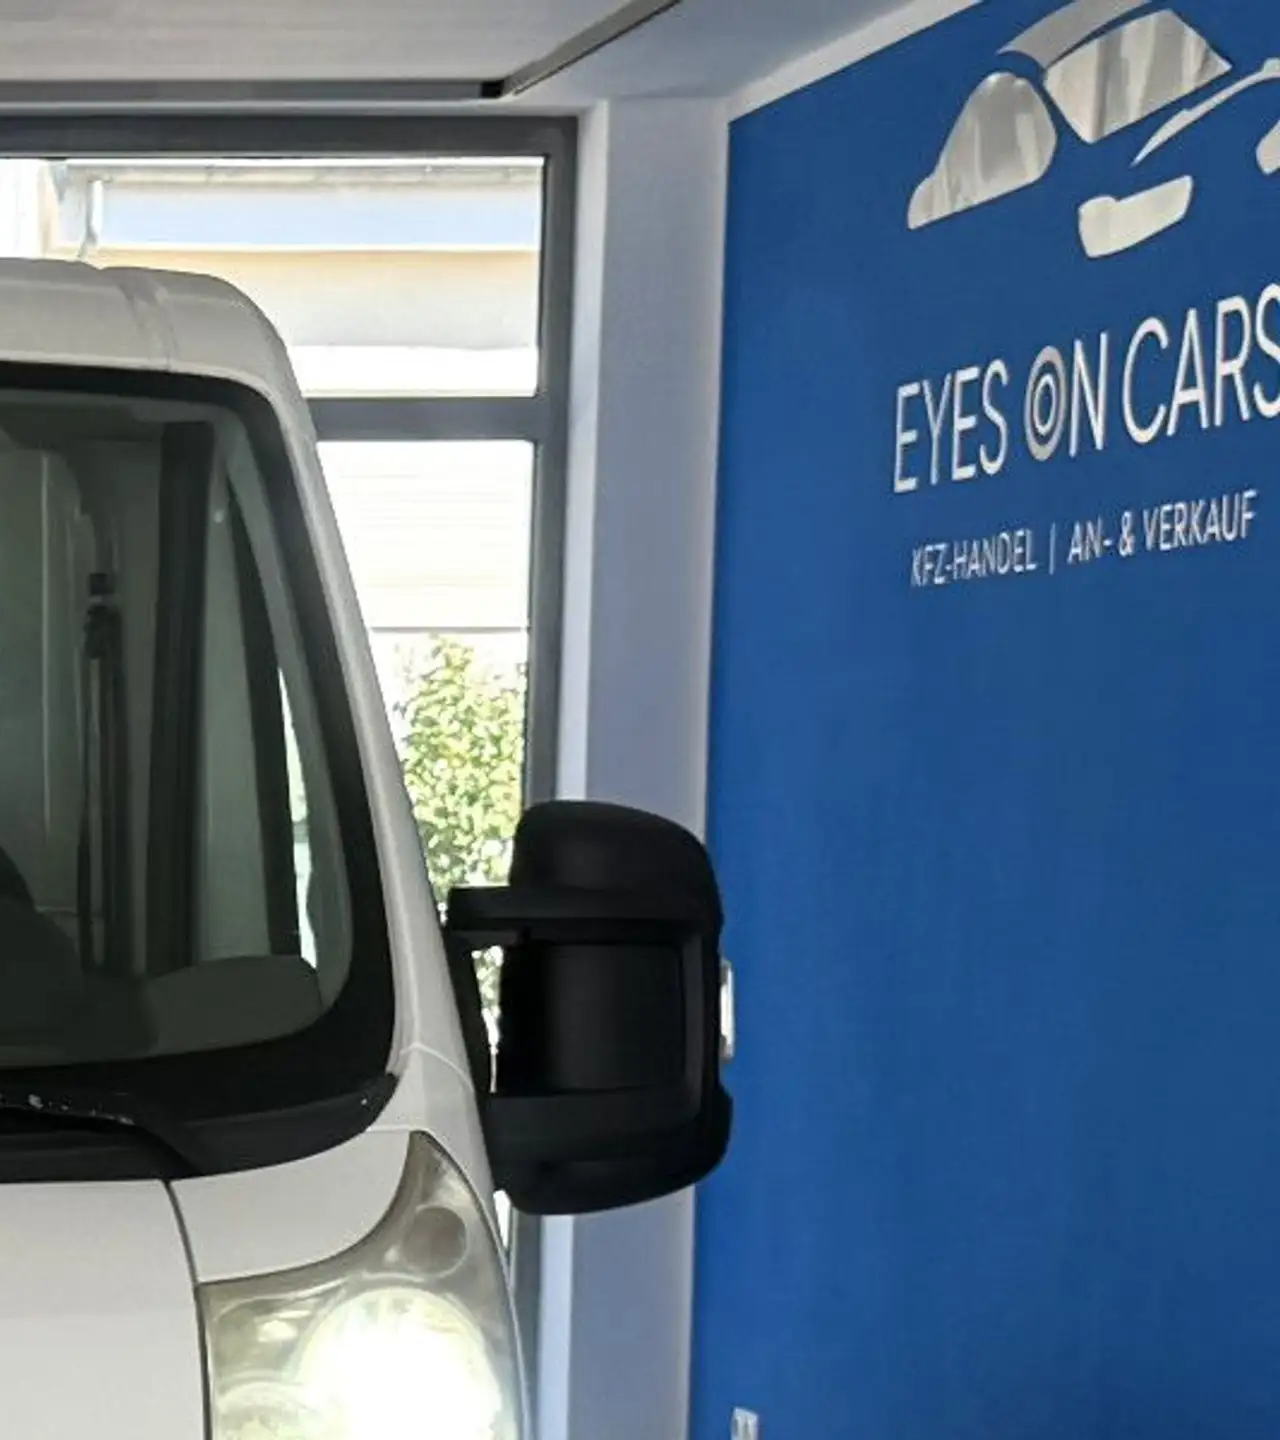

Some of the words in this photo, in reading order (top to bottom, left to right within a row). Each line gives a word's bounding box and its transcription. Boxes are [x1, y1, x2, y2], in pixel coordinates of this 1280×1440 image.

[893, 358, 1009, 493] EYES
[1023, 330, 1109, 462] ON
[1122, 283, 1280, 443] CARS
[910, 528, 1037, 587] KFZ-HANDEL
[1067, 515, 1113, 565] AN-
[1118, 511, 1136, 557] &
[1143, 489, 1258, 552] VERKAUF
